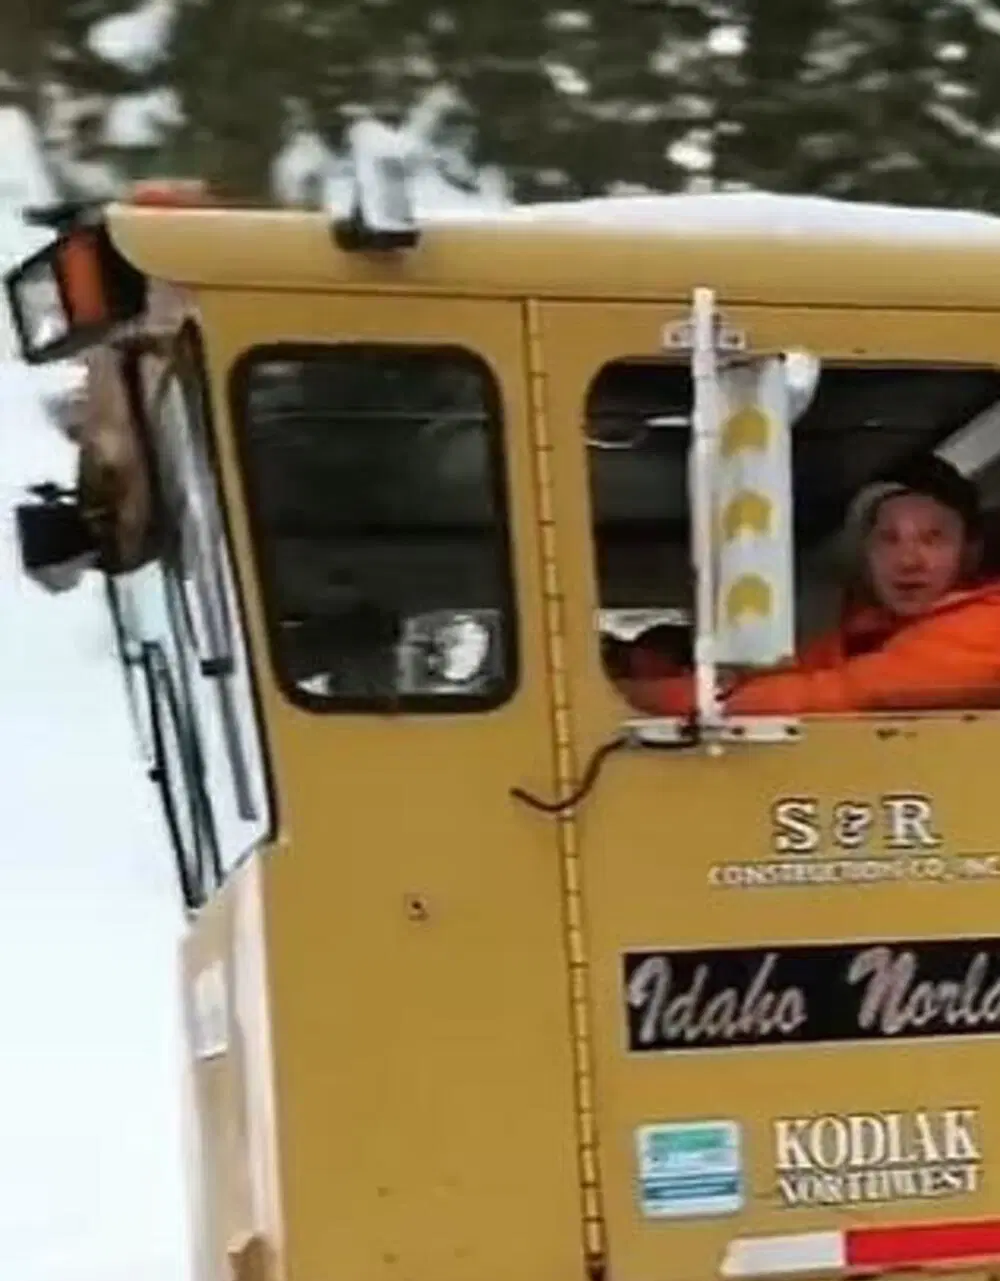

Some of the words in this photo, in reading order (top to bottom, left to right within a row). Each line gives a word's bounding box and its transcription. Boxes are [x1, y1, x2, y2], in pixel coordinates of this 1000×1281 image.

[773, 797, 820, 853] S
[832, 800, 874, 849] &
[881, 793, 944, 849] R
[629, 954, 808, 1043] Idaho
[773, 1106, 982, 1171] KODIAK
[777, 1164, 983, 1207] NORTHWEST
